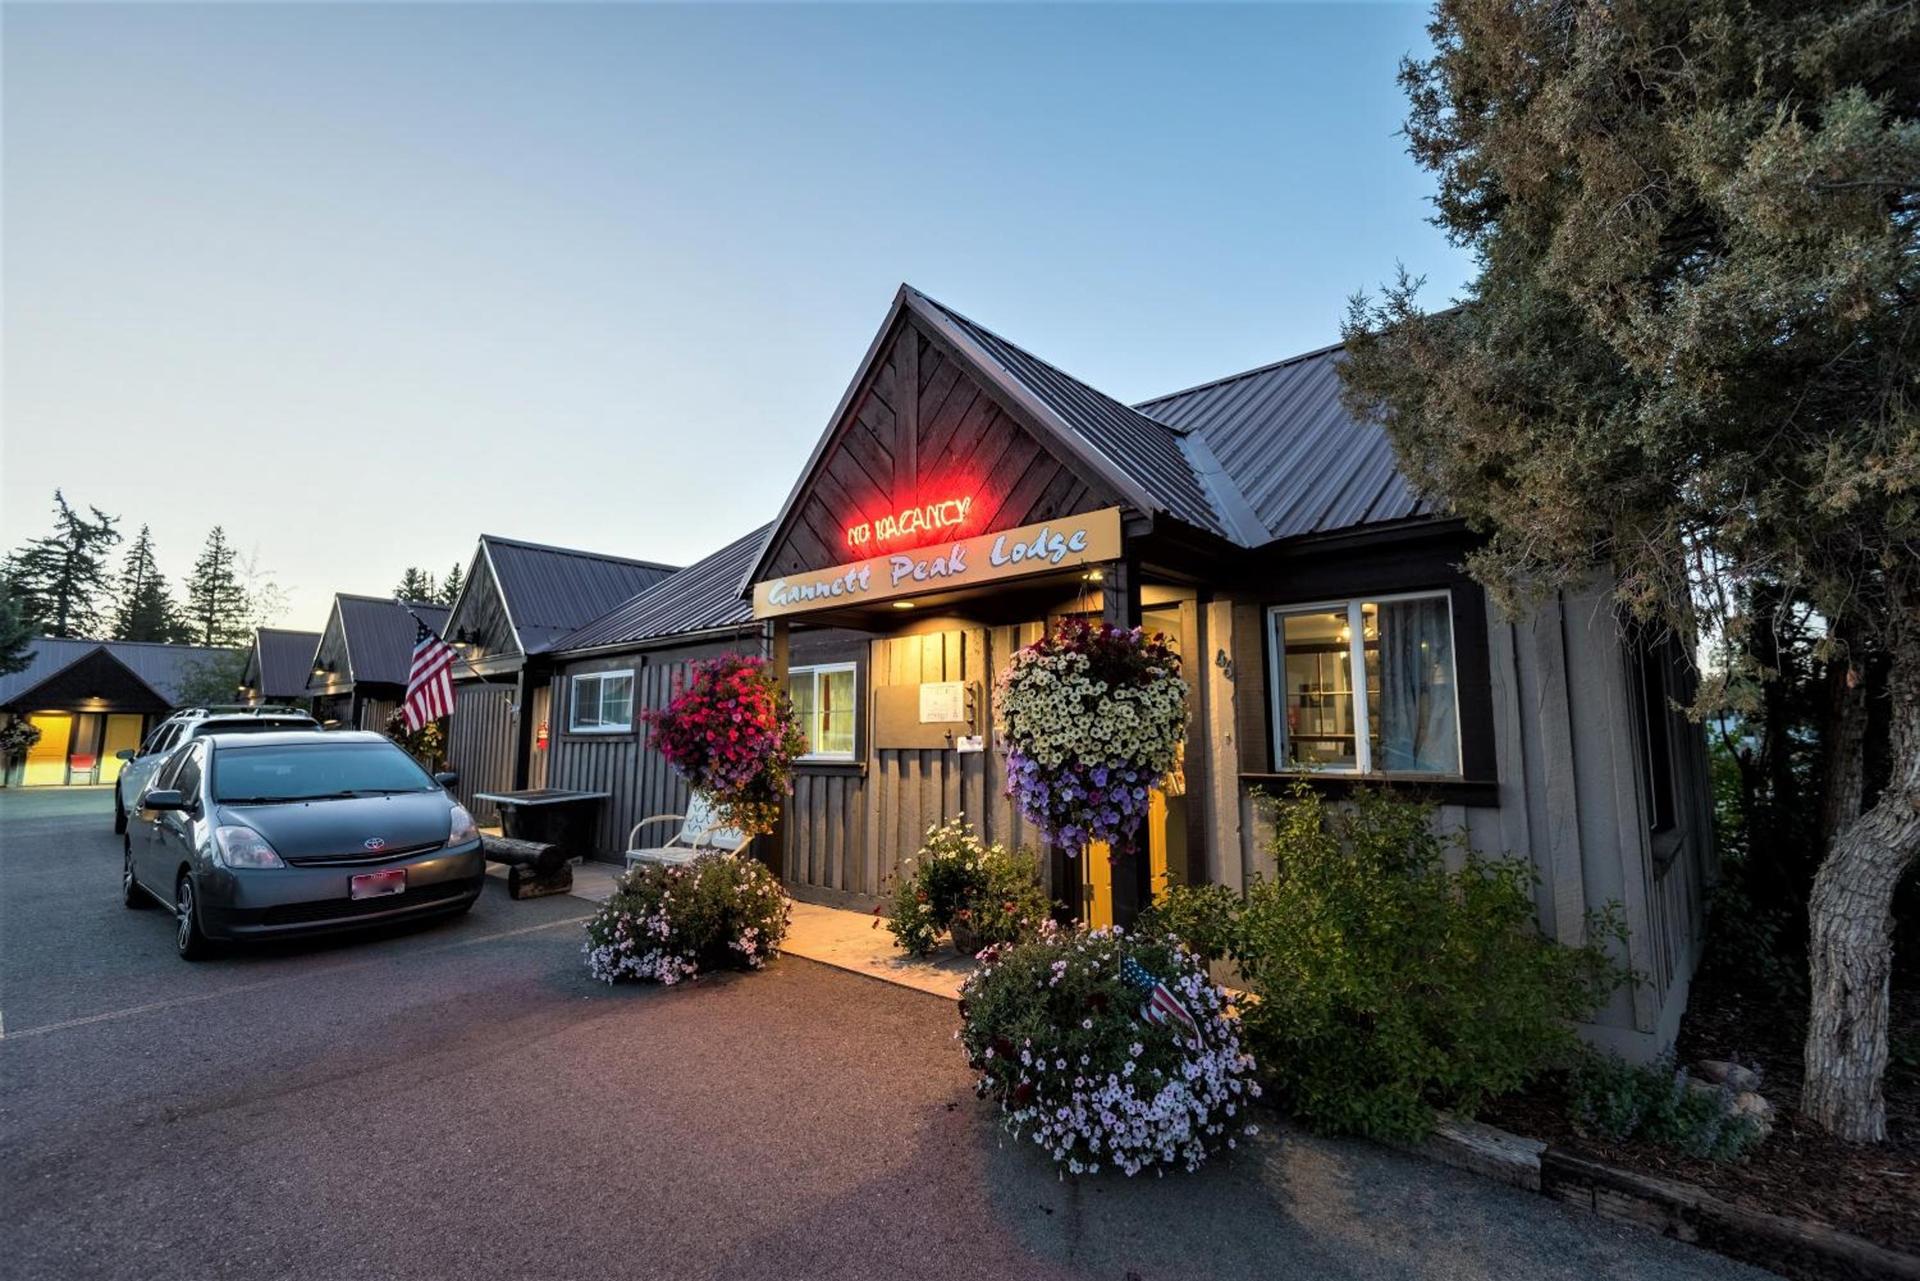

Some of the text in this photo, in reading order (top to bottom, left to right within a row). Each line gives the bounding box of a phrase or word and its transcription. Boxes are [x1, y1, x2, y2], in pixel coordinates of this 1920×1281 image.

[847, 496, 972, 546] NO VACANCY
[769, 528, 1088, 606] Gannett Peak Lodge
